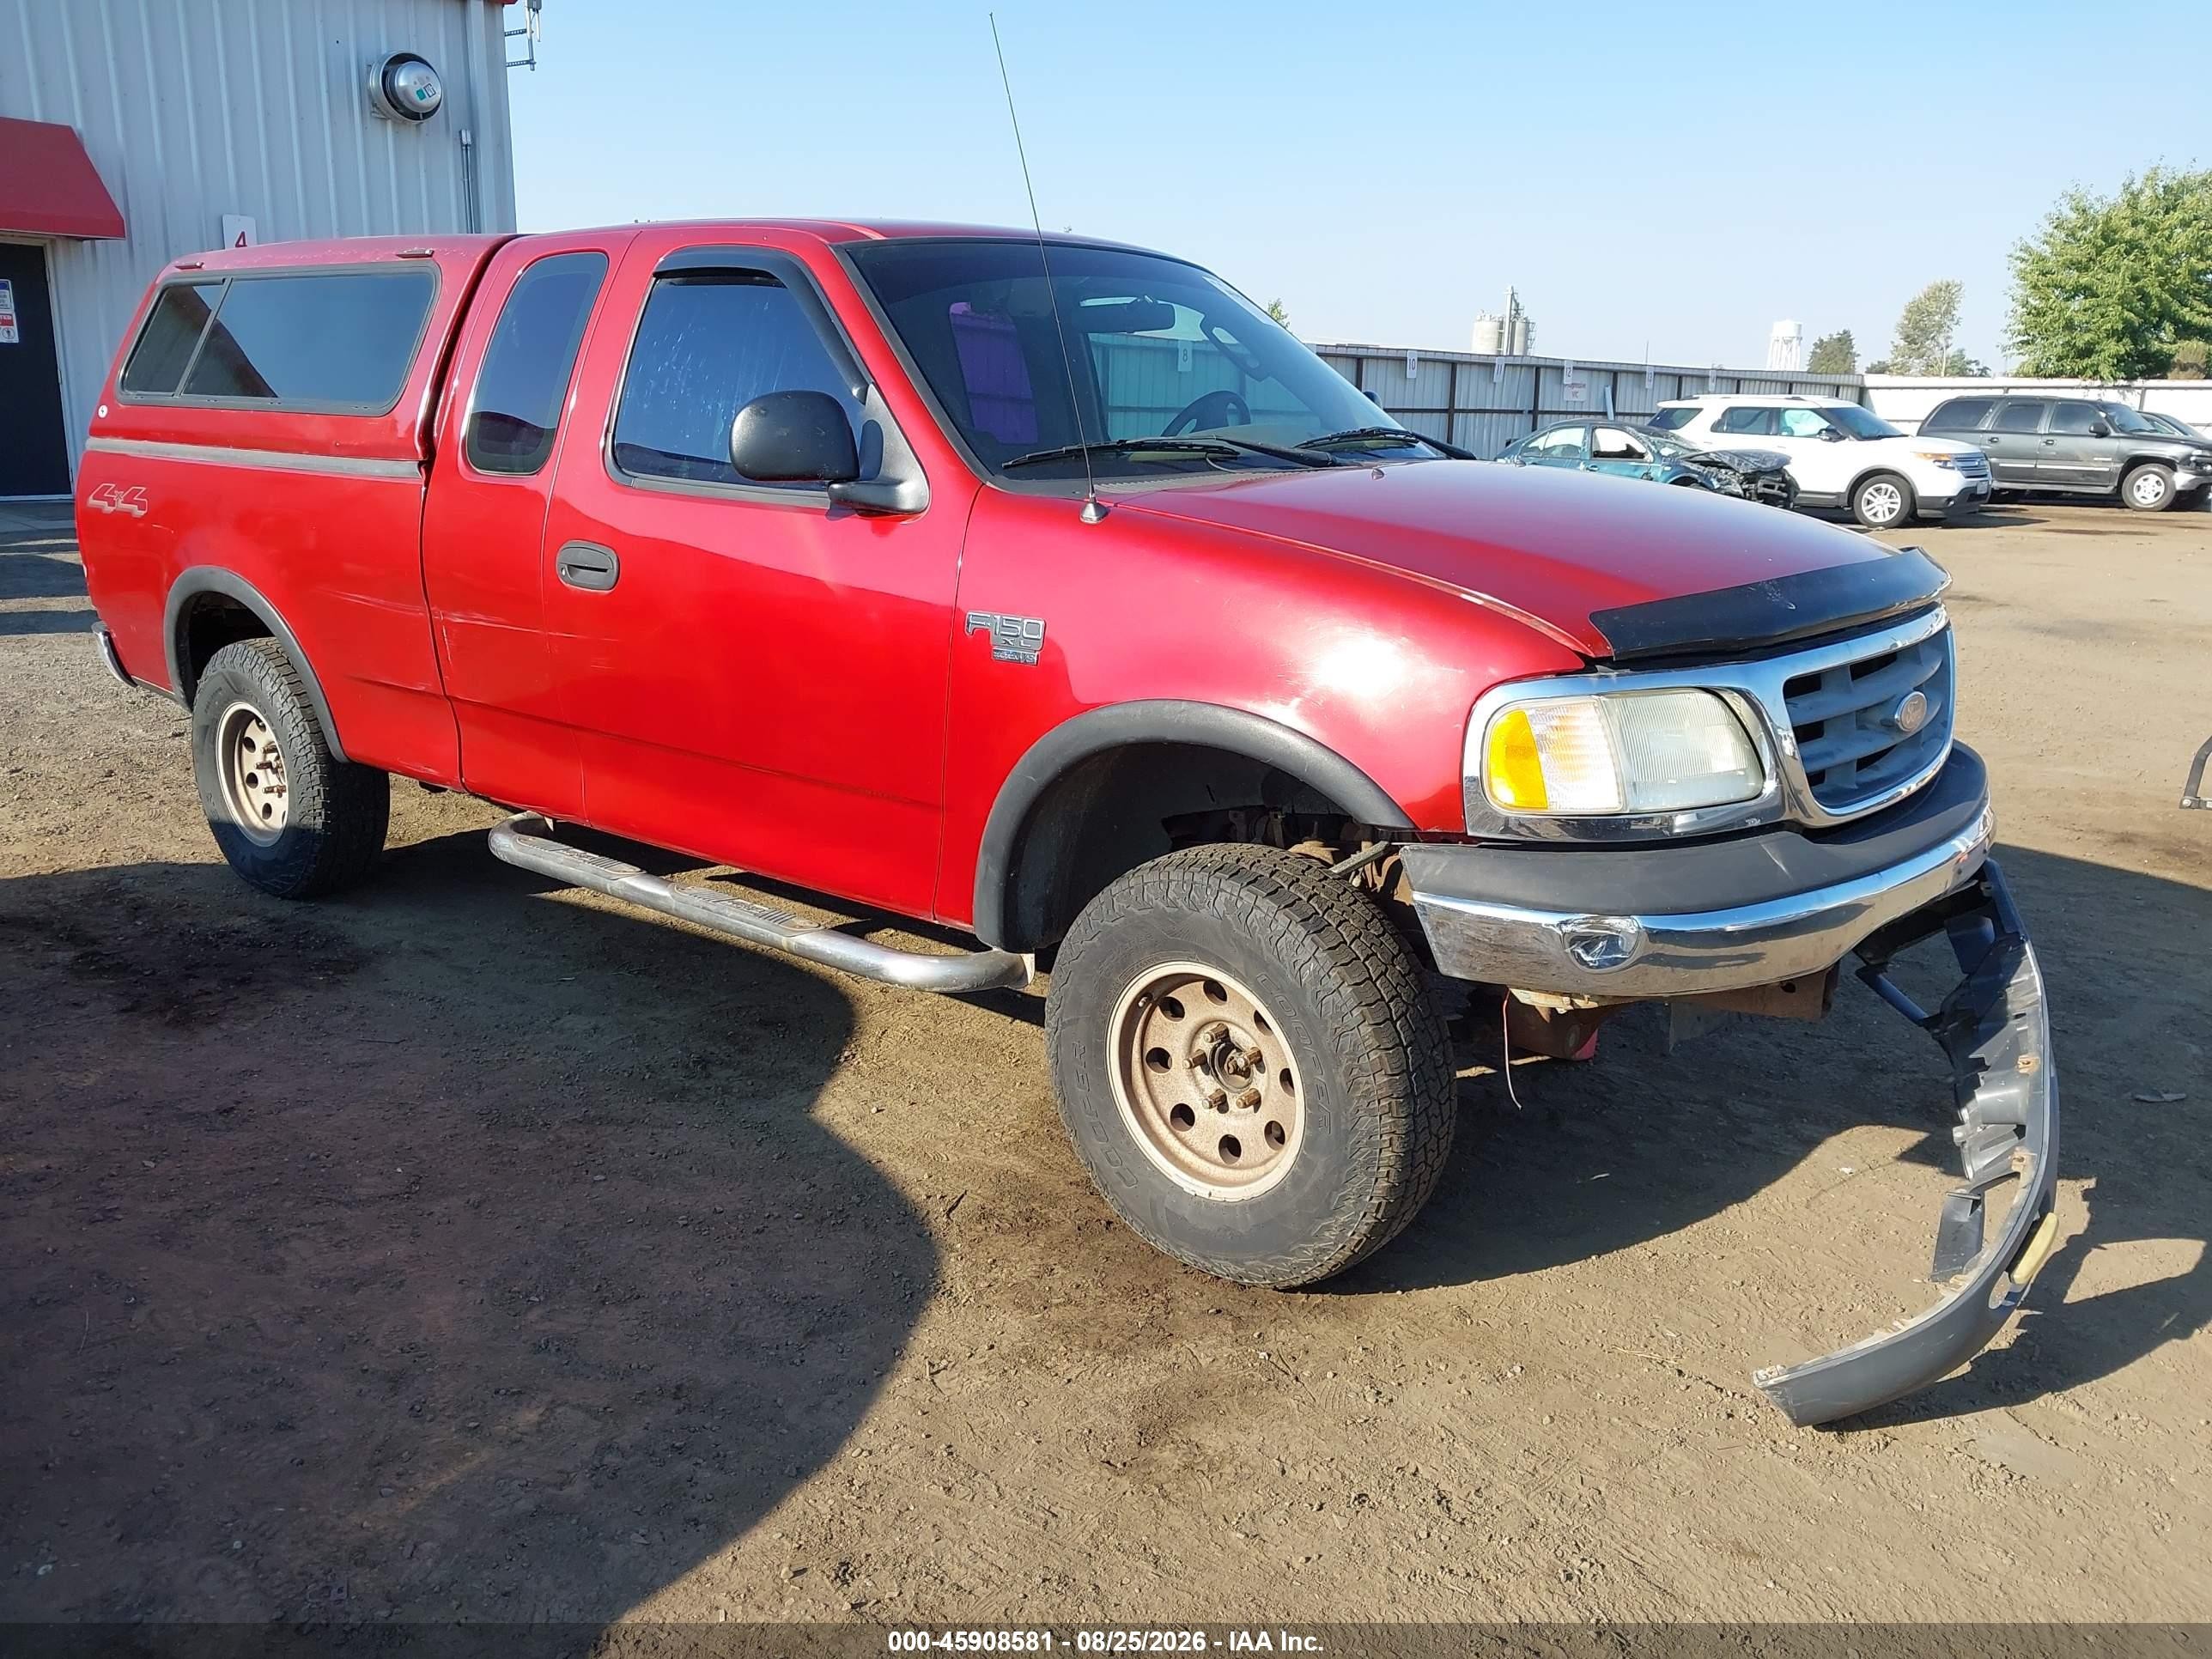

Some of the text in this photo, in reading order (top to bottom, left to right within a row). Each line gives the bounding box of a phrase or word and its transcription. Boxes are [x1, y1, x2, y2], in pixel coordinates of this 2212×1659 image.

[234, 231, 247, 247] 4
[1182, 349, 1188, 362] 8
[1408, 358, 1416, 370] 10
[1001, 637, 1031, 647] XL
[1256, 973, 1332, 1135] COOPER
